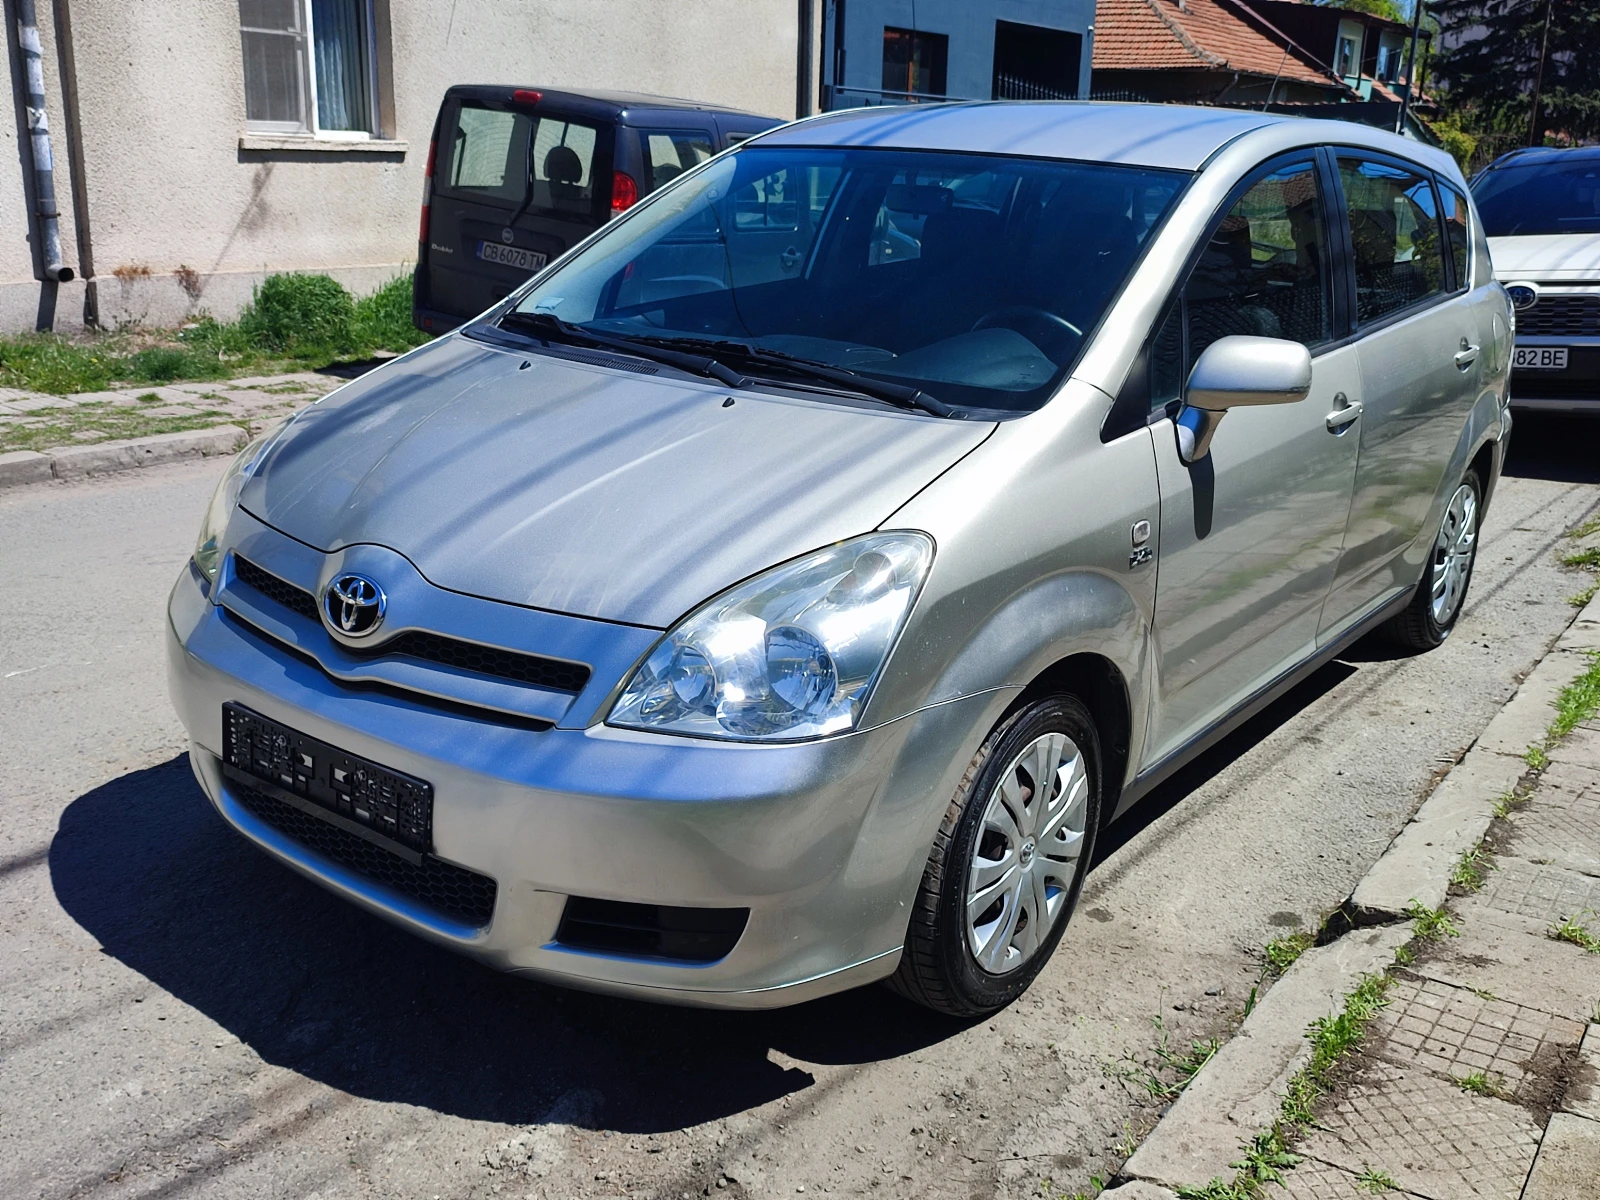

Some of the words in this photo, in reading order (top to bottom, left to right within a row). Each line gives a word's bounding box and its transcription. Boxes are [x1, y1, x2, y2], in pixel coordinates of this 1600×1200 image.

[483, 244, 498, 260] CB
[499, 247, 527, 267] 6078
[529, 253, 545, 270] TM
[1513, 350, 1538, 366] 82
[1540, 350, 1565, 366] BE
